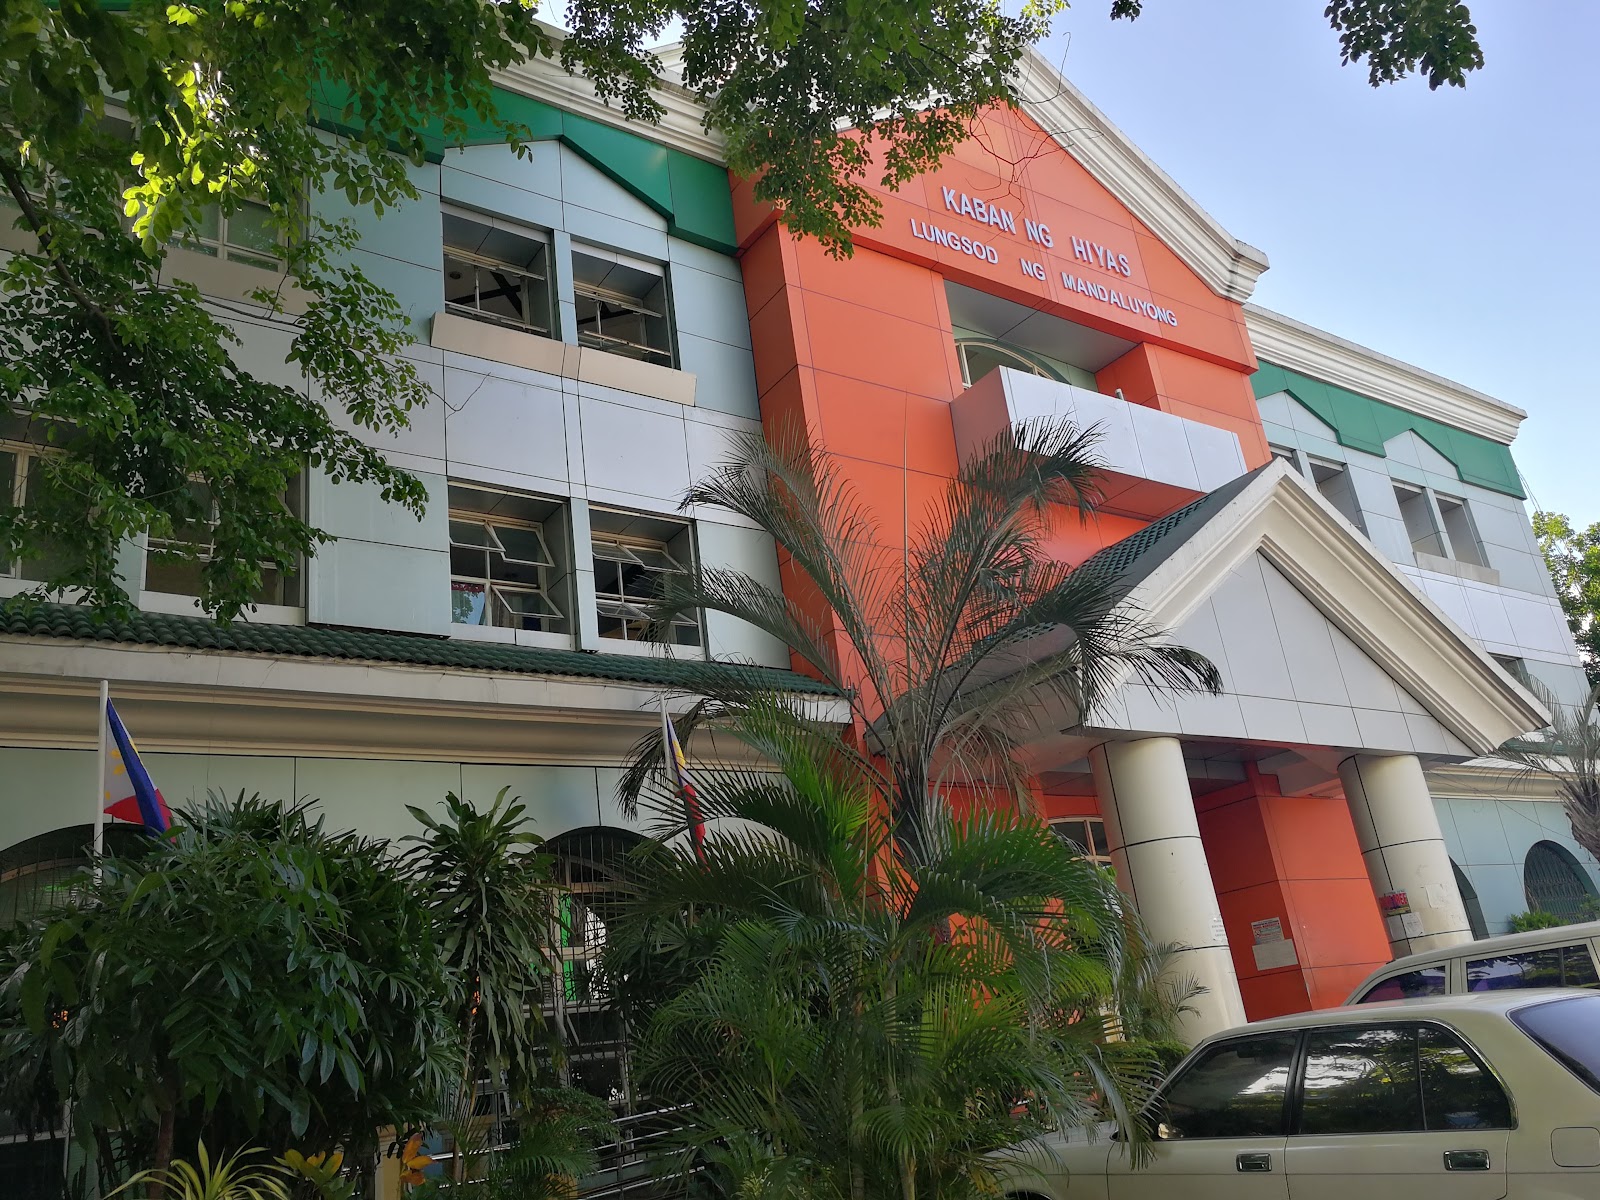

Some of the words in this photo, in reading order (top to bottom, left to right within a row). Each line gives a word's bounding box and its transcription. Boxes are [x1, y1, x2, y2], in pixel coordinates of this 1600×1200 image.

[910, 218, 999, 264] LUNGSOD
[1020, 257, 1046, 281] NG
[1061, 271, 1178, 327] MANDALUYONG
[941, 185, 1017, 235] KABAN
[1024, 218, 1054, 248] NG
[1071, 235, 1131, 277] HIYAS
